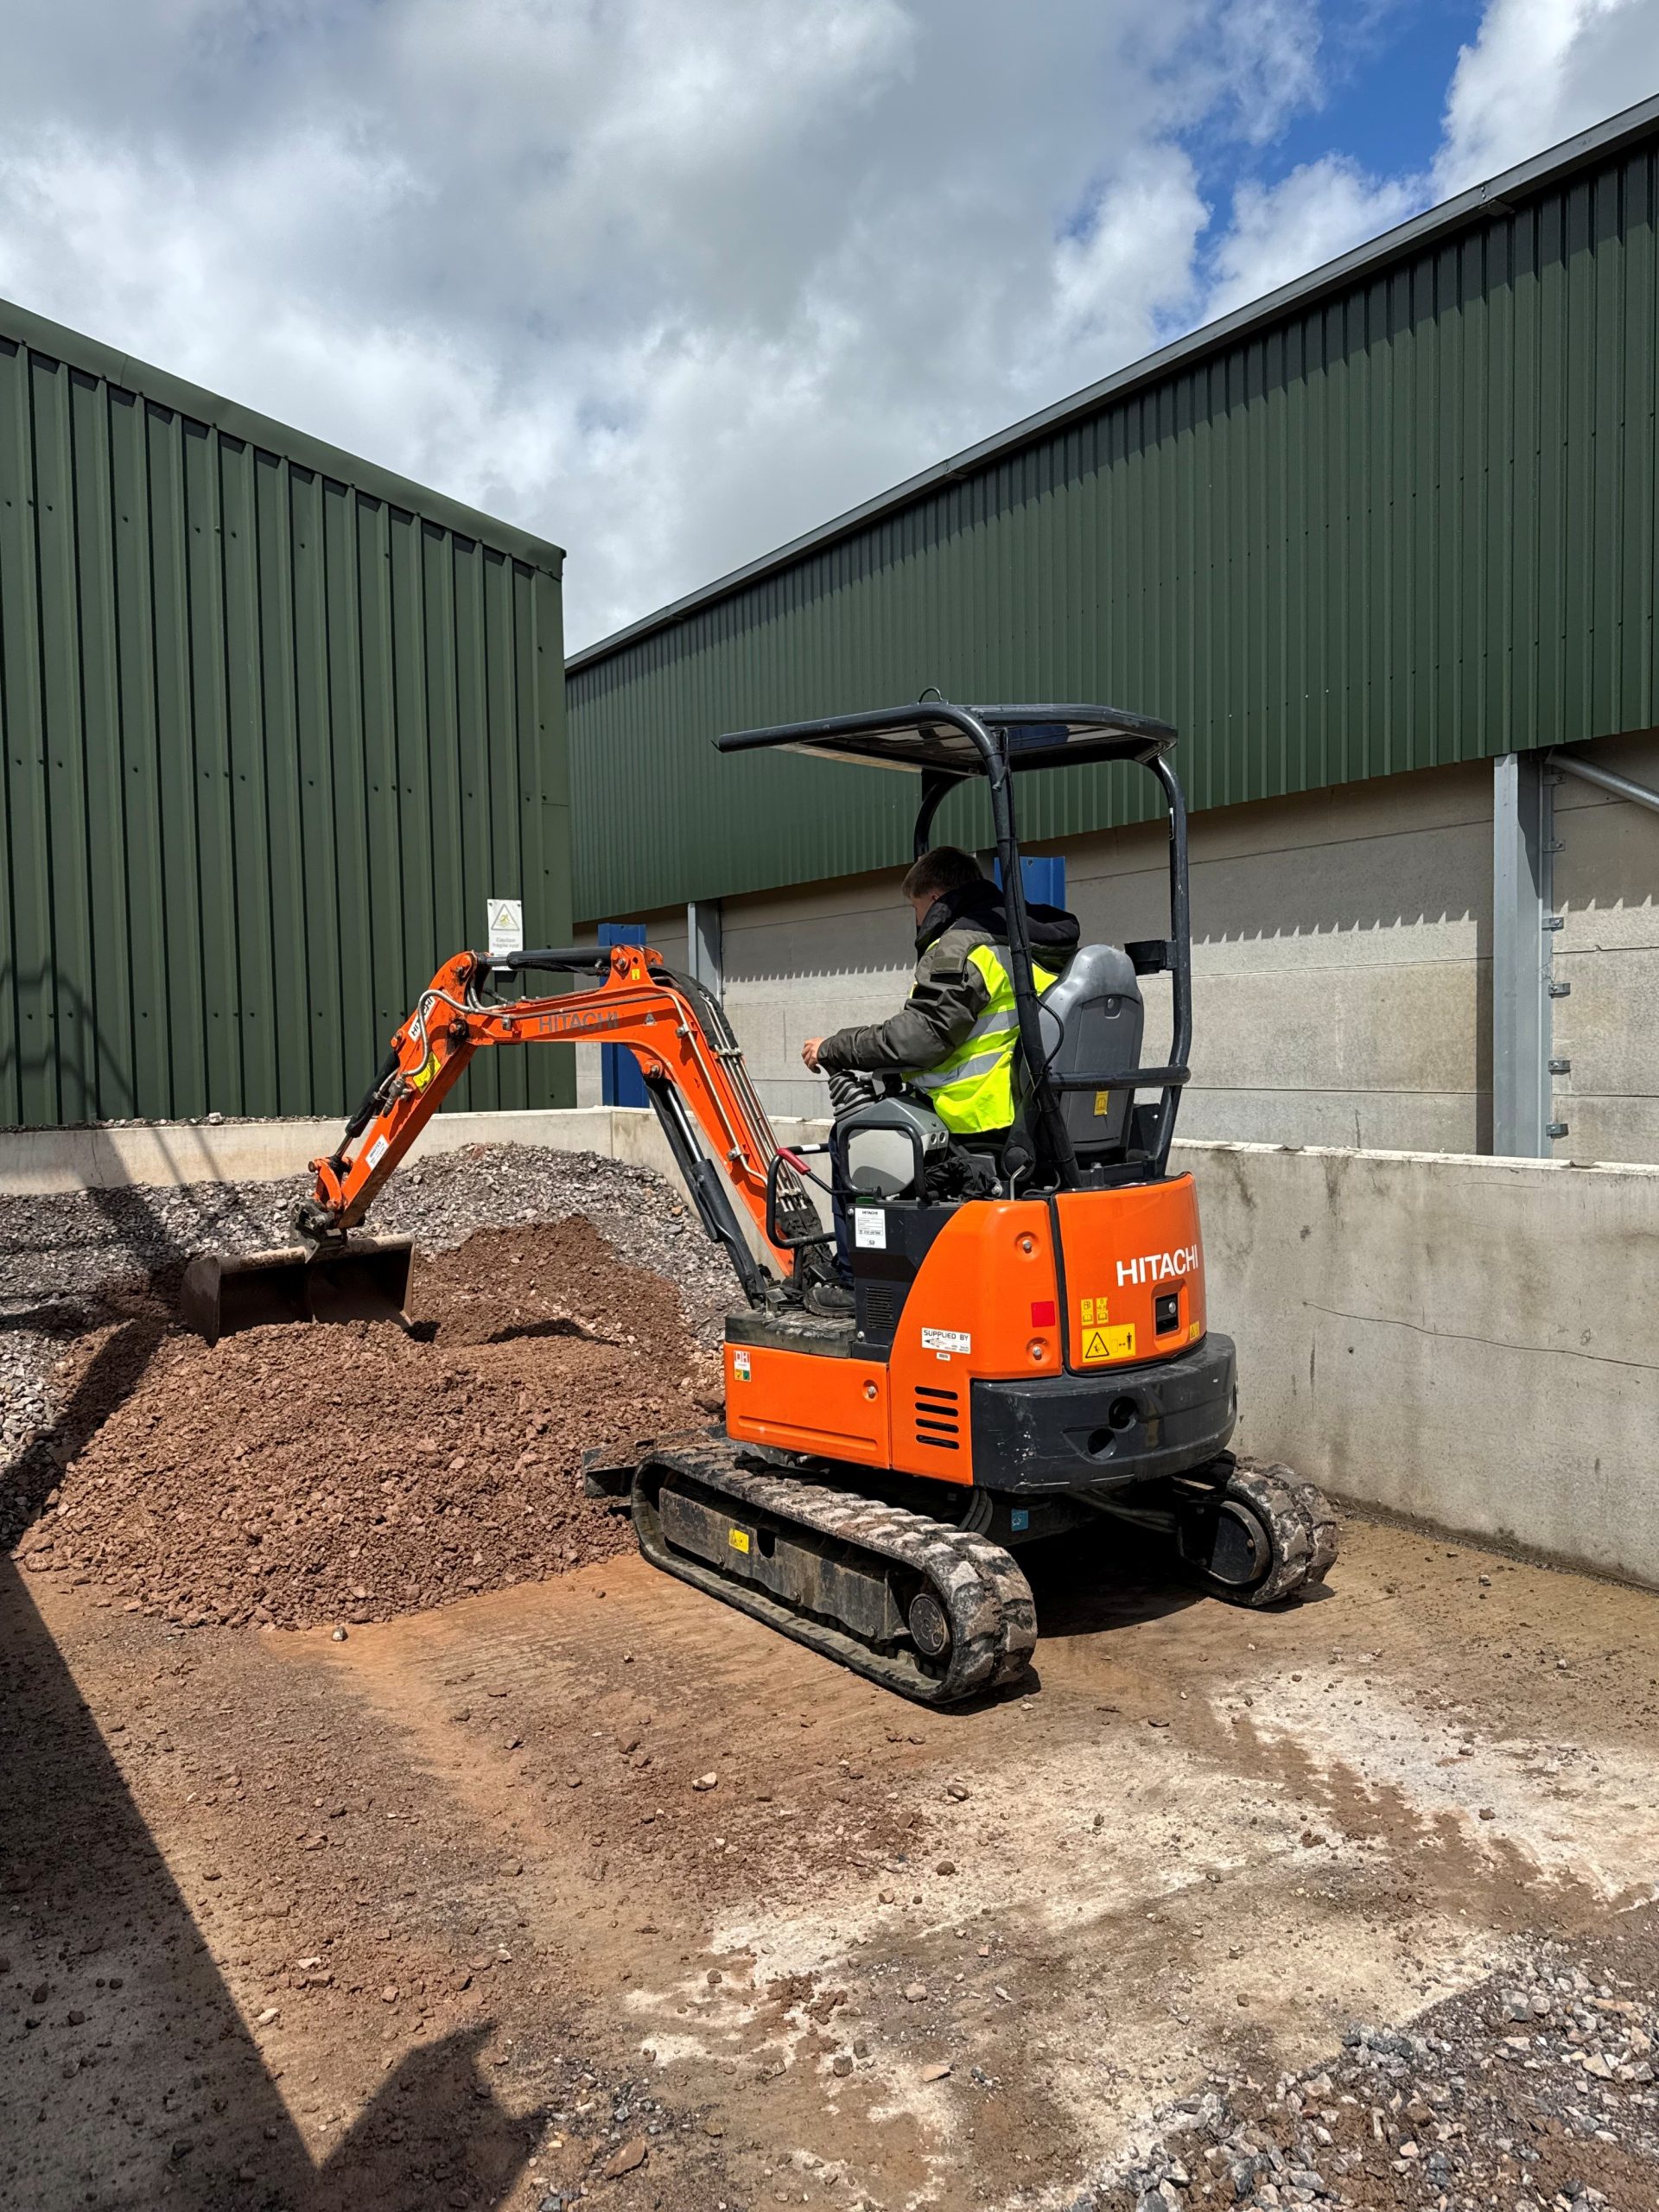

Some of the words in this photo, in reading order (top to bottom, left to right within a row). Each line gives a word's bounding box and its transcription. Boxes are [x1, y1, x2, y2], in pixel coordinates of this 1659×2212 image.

[538, 1011, 620, 1033] HITACHI
[1116, 1244, 1198, 1287] HITACHI
[924, 1330, 957, 1339] SUPPLIED
